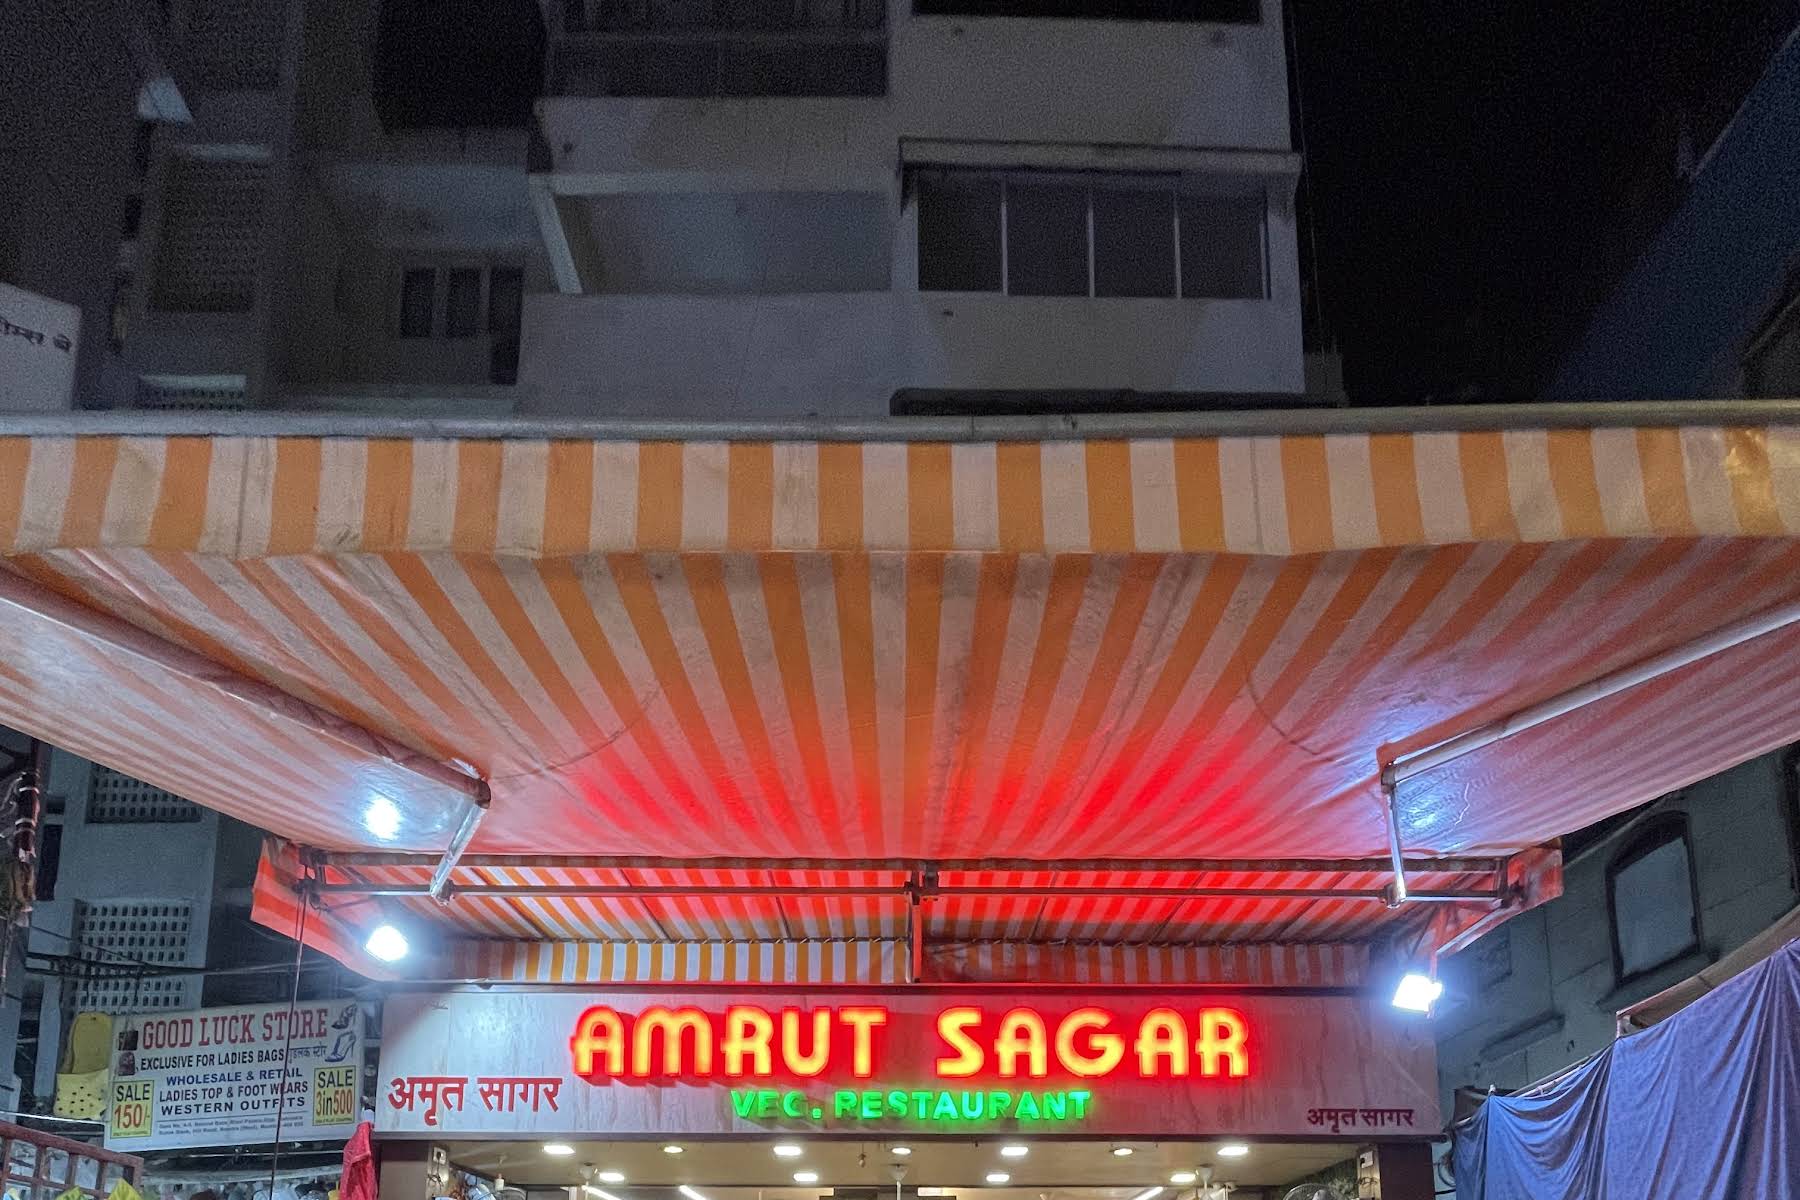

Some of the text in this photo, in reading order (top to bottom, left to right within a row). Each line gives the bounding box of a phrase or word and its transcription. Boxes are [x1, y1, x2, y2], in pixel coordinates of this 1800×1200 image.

[143, 1008, 328, 1049] GOOD LUCK STORE
[571, 1005, 1249, 1077] AMRUT SAGAR
[140, 1048, 284, 1071] EXCLUSIVE FOR LADIES BAGS
[166, 1067, 303, 1087] WHOLESALE & RETAIL
[318, 1069, 353, 1089] SALE
[115, 1083, 151, 1102] SALE
[159, 1088, 198, 1103] LADIES
[201, 1086, 223, 1100] TOP
[226, 1086, 234, 1099] &
[238, 1083, 267, 1098] FOOT
[388, 1077, 563, 1126] अमृत सागर
[114, 1103, 151, 1129] 150/-
[161, 1096, 305, 1116] WESTERN OUTFITS
[834, 1090, 1091, 1120] RESTAURANT
[1307, 1108, 1414, 1133] अमृत सागर
